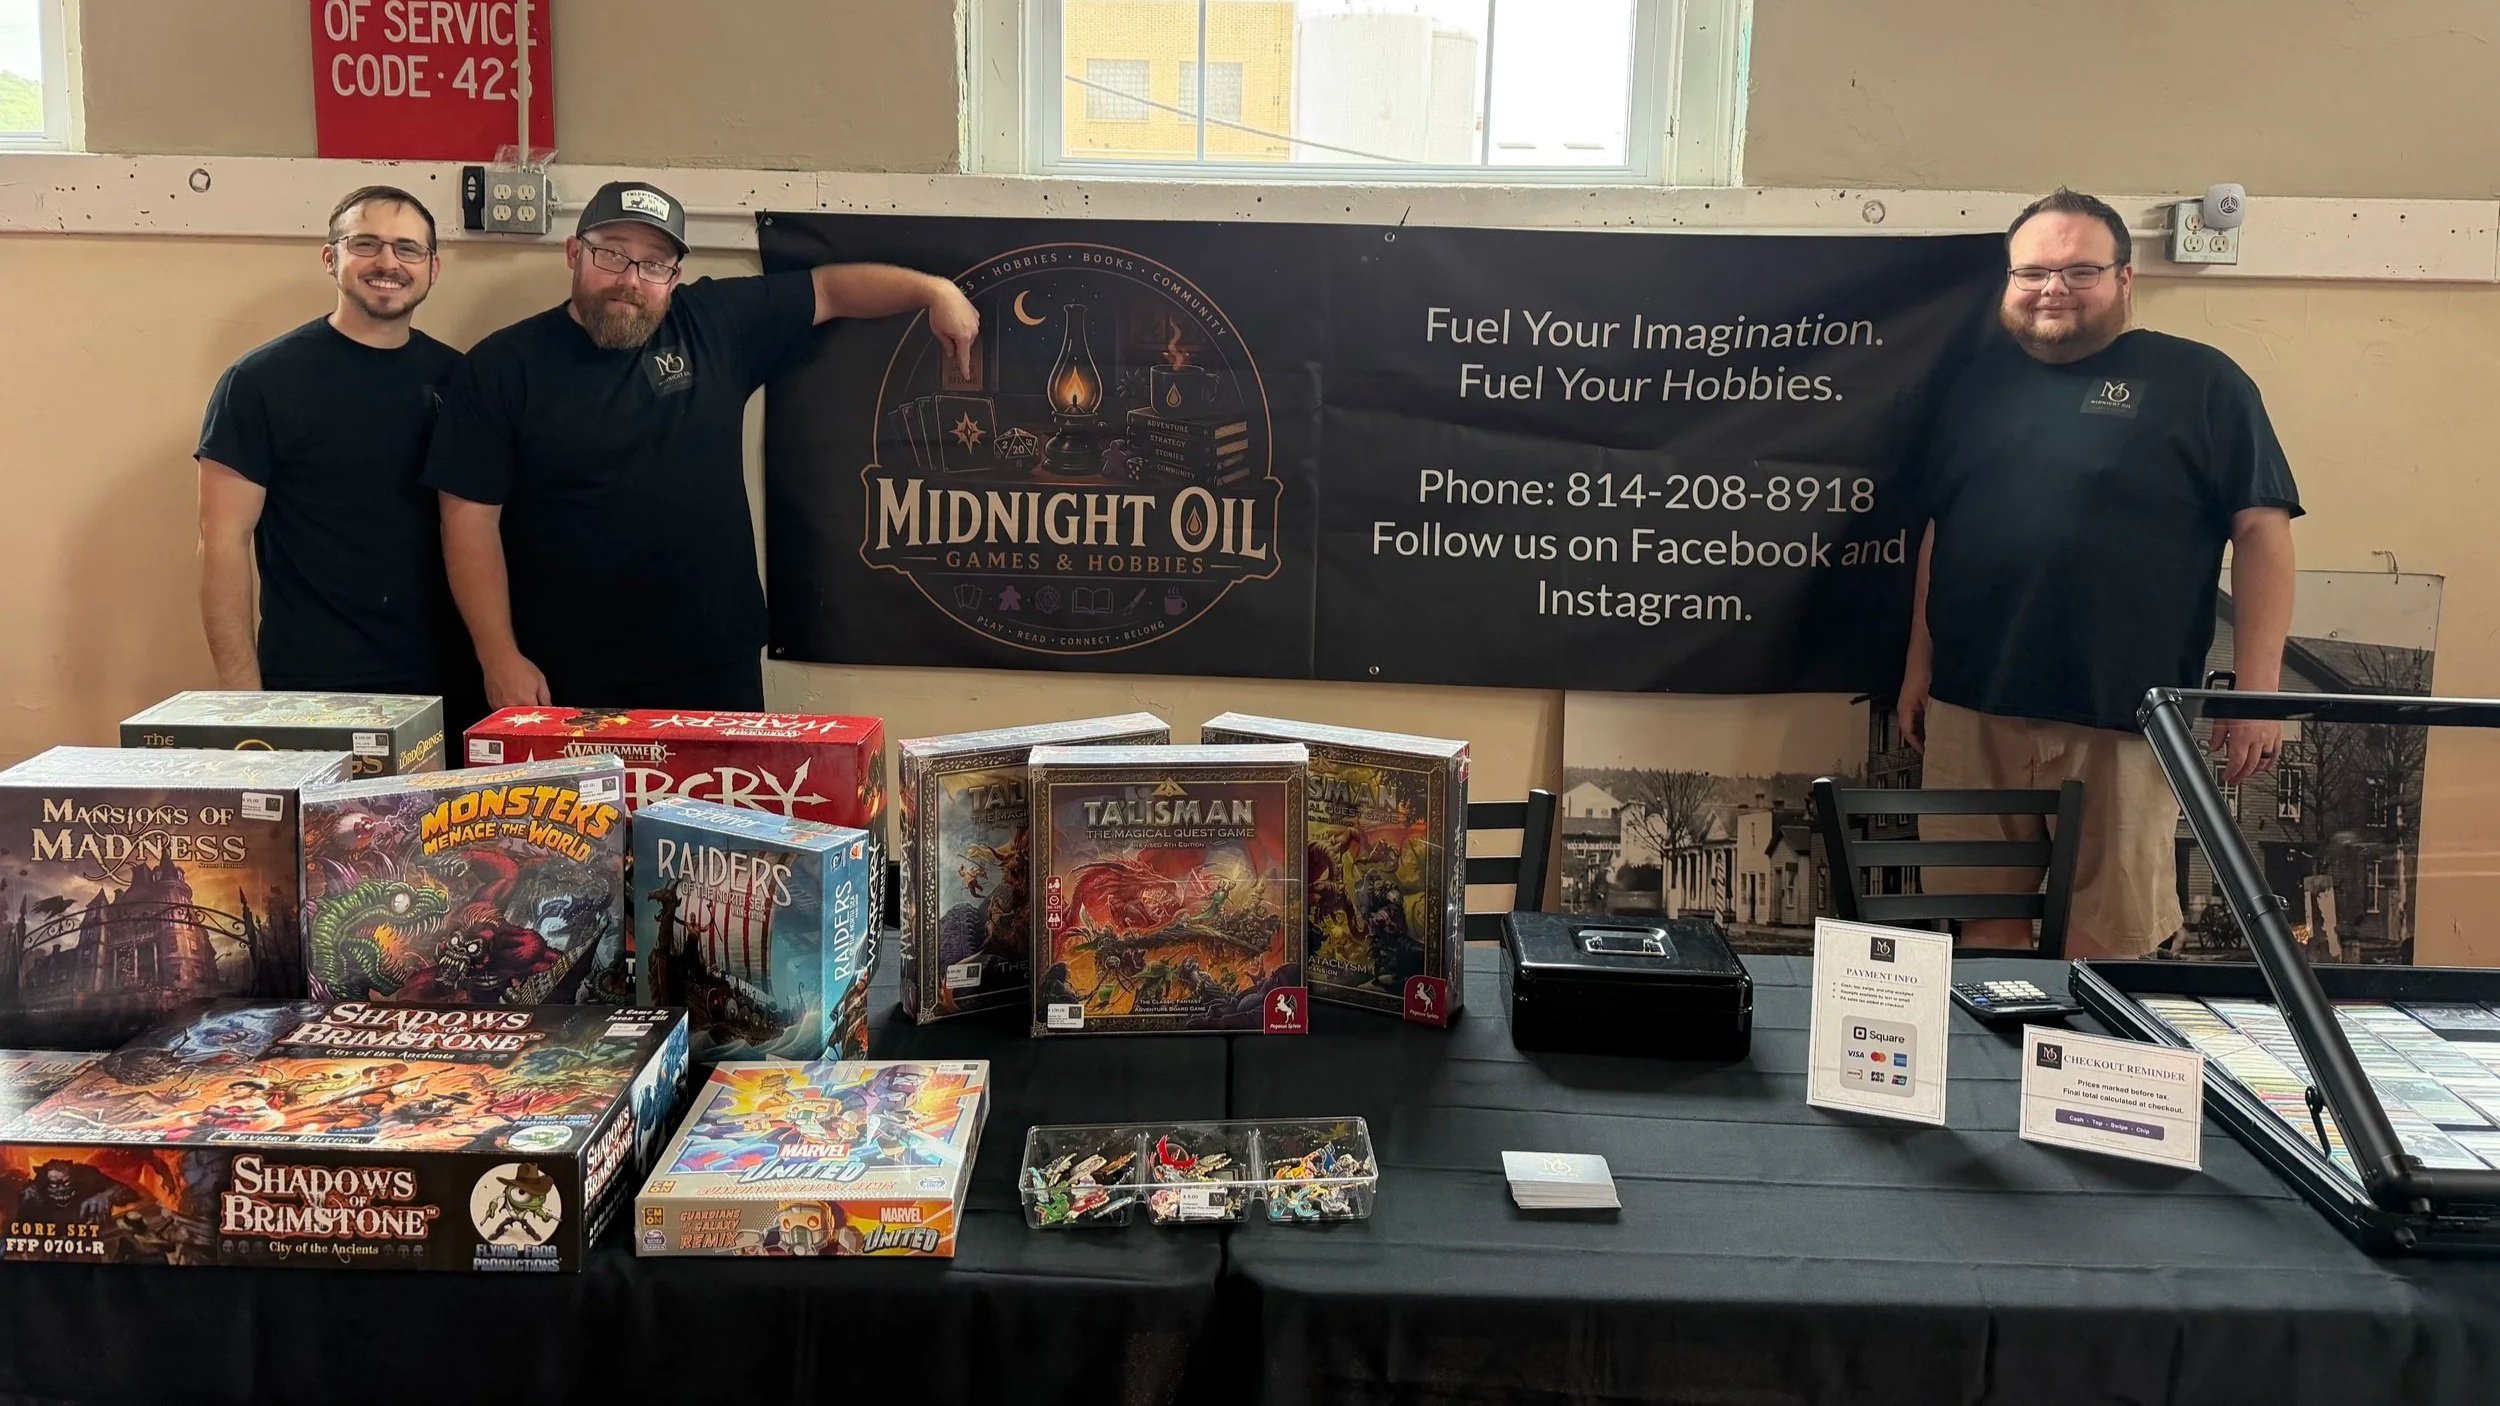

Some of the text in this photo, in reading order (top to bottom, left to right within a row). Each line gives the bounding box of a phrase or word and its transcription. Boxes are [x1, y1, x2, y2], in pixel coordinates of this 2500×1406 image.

[324, 0, 537, 46] OF SERVICE
[331, 53, 533, 100] CODE 423
[992, 253, 1226, 337] HOBBIES BOOKS COMMUNITY
[1426, 307, 1884, 357] Fuel Your Imagination.
[1459, 364, 1843, 402] Fuel Your Hobbies.
[1147, 420, 1189, 433] ADVENTURE
[1013, 445, 1024, 454] 20
[1150, 434, 1187, 448] STRATEGY
[1155, 448, 1184, 461] STORIES
[1157, 464, 1196, 480] COMMUNITY
[1419, 468, 1876, 513] Phone: 814-208-8918
[876, 477, 1268, 560] MIDNIGHT OIL
[1372, 521, 1906, 568] Follow us on Facebook and
[946, 551, 1205, 574] GAMES & HOBBIES
[1538, 580, 1752, 627] Instagram.
[976, 615, 1165, 646] PLAY READ CONNECT BELONG
[566, 744, 664, 761] WARHAMMER
[1308, 775, 1397, 810] SMAN
[42, 798, 189, 826] MANSIONS
[199, 807, 234, 826] OF
[421, 786, 623, 842] MONSTERS
[1083, 800, 1255, 827] TALISMAN
[423, 820, 593, 862] MENACE THE WORLD
[1086, 827, 1255, 840] THE MAGICAL QUEST GAME
[31, 828, 247, 863] MADNESS
[658, 838, 792, 907] RAIDERS
[682, 882, 766, 911] OF THE NORTH SEA
[834, 880, 852, 982] RAIDERS
[1309, 955, 1368, 974] ATACLYSM
[1846, 967, 1918, 984] PAYMENT INFO
[323, 1003, 532, 1031] SHADOWS
[445, 1025, 468, 1033] OF
[1869, 1030, 1905, 1044] Square
[325, 1048, 454, 1062] City of the Ancients
[1847, 1050, 1865, 1059] VISA
[2064, 1055, 2125, 1072] CHECKOUT
[2127, 1065, 2186, 1082] REMINDER
[2063, 1087, 2081, 1097] Final
[2082, 1091, 2098, 1099] total
[2100, 1094, 2138, 1107] calculated
[2148, 1102, 2184, 1114] checkout.
[2077, 1079, 2169, 1100] Prices marked before tax.
[2069, 1114, 2150, 1135] Cash Tap Swipe Chip
[587, 1105, 630, 1175] SHADOWS
[780, 1144, 851, 1159] MARVEL
[233, 1156, 414, 1198] SHADOWS
[584, 1128, 633, 1209] BRIMSTONE
[739, 1159, 869, 1183] UNITED
[348, 1196, 368, 1208] OF
[680, 1209, 741, 1221] GUARDIANS
[694, 1219, 741, 1232] GALAXY
[880, 1206, 924, 1224] MARVEL
[11, 1222, 100, 1237] CORE SET
[680, 1232, 739, 1249] REMIX
[862, 1225, 942, 1254] UNITED
[6, 1238, 104, 1255] FFP 0701-R
[269, 1242, 379, 1260] City of the Ancients
[476, 1244, 557, 1258] FLYING FROG
[472, 1258, 560, 1272] PRODUCTIONS
